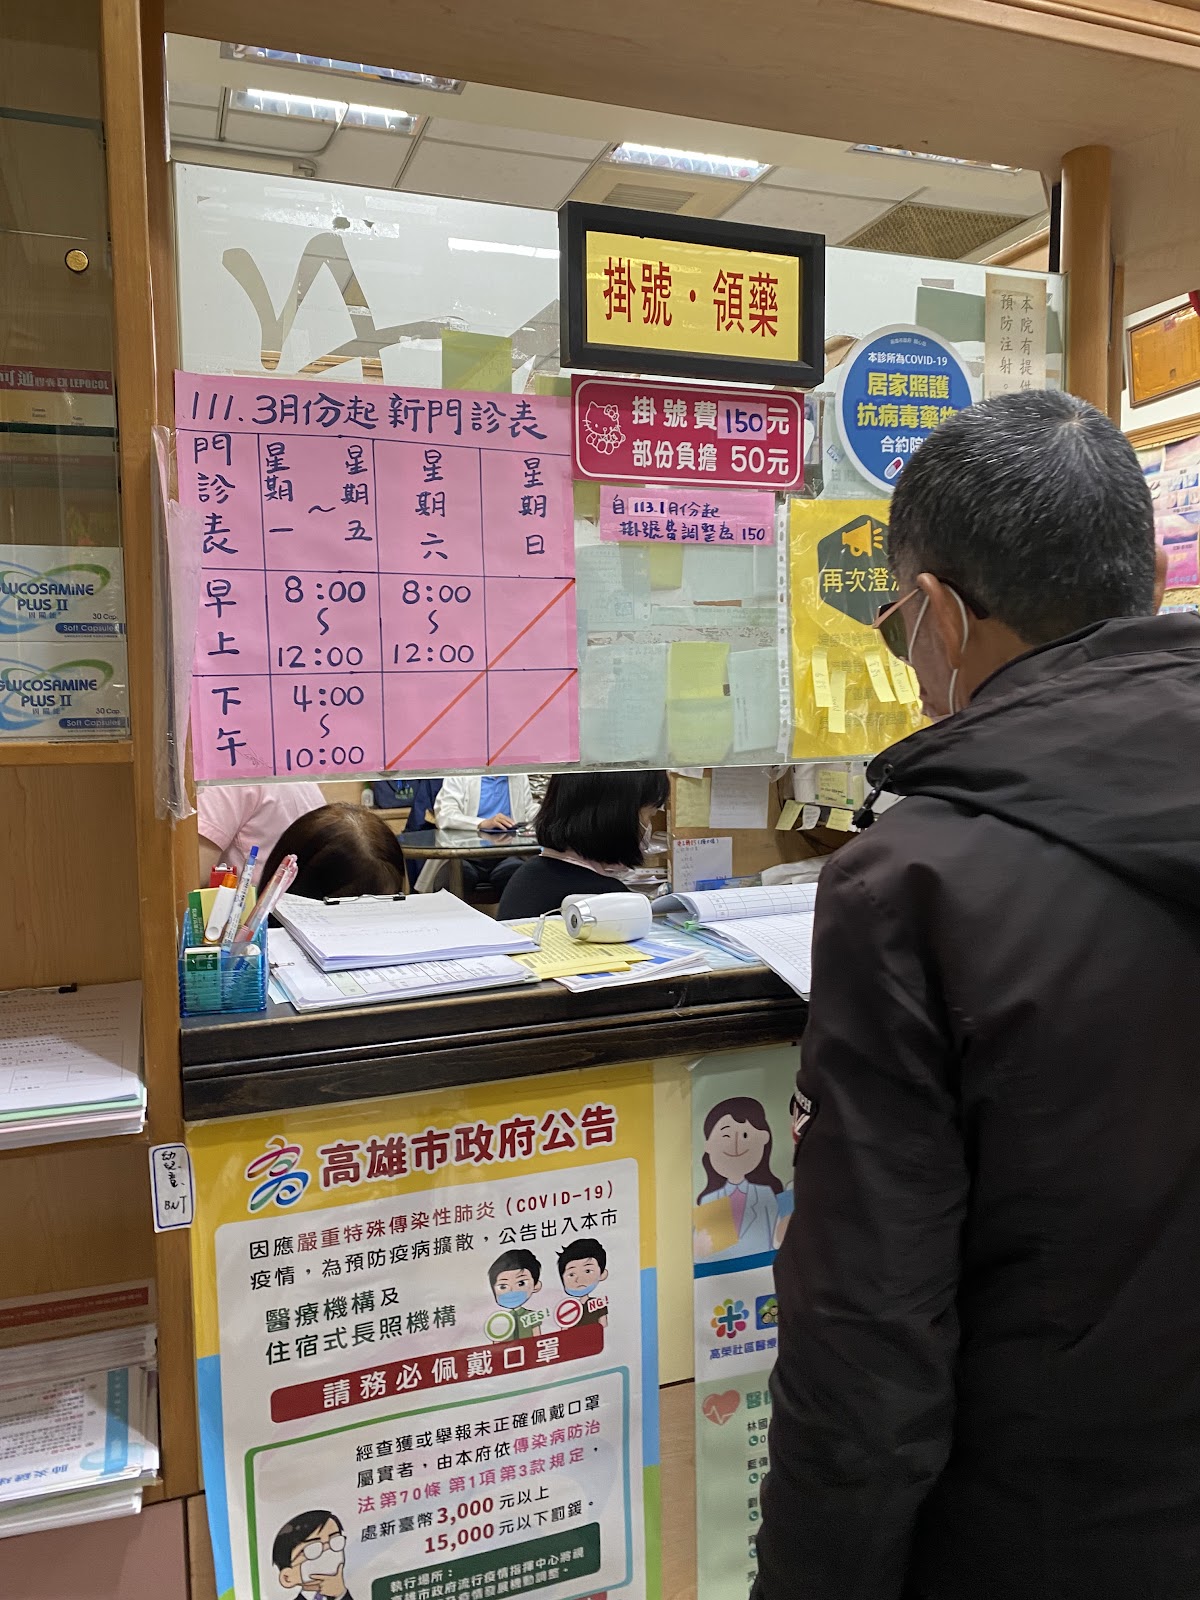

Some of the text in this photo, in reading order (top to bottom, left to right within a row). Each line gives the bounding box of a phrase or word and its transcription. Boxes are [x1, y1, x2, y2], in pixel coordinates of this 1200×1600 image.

[868, 352, 948, 366] 本診所為COVID-19
[867, 372, 950, 399] 居家照護
[632, 438, 789, 475] 部份負擔 50元
[880, 436, 928, 454] 合約院
[193, 433, 239, 554] 門診表
[264, 442, 294, 533] 星期一
[340, 445, 373, 541] 星期五
[415, 450, 448, 559] 星期六
[518, 457, 547, 555] 星期日
[0, 583, 94, 595] LUCOSAMINE
[285, 576, 366, 603] 8:00
[402, 580, 471, 604] 8:00
[17, 599, 52, 611] PLUS
[204, 579, 240, 655] 早上
[63, 624, 79, 632] Soft
[278, 646, 363, 668] 12:00
[394, 643, 474, 664] 12:00
[21, 695, 56, 706] PLUS
[294, 685, 364, 712] 4:00
[66, 719, 82, 727] Soft
[211, 686, 247, 766] 下午
[286, 746, 364, 771] 10:00
[320, 1106, 616, 1187] 高雄市政府公告
[265, 1287, 400, 1333] 醫療機構及
[521, 1308, 550, 1325] YES!
[589, 1296, 609, 1311] NG!
[265, 1305, 456, 1365] 住宿式長照機構
[323, 1337, 560, 1408] 請務必佩戴口罩
[356, 1394, 600, 1462] 經查獲或舉報未正確佩戴口罩
